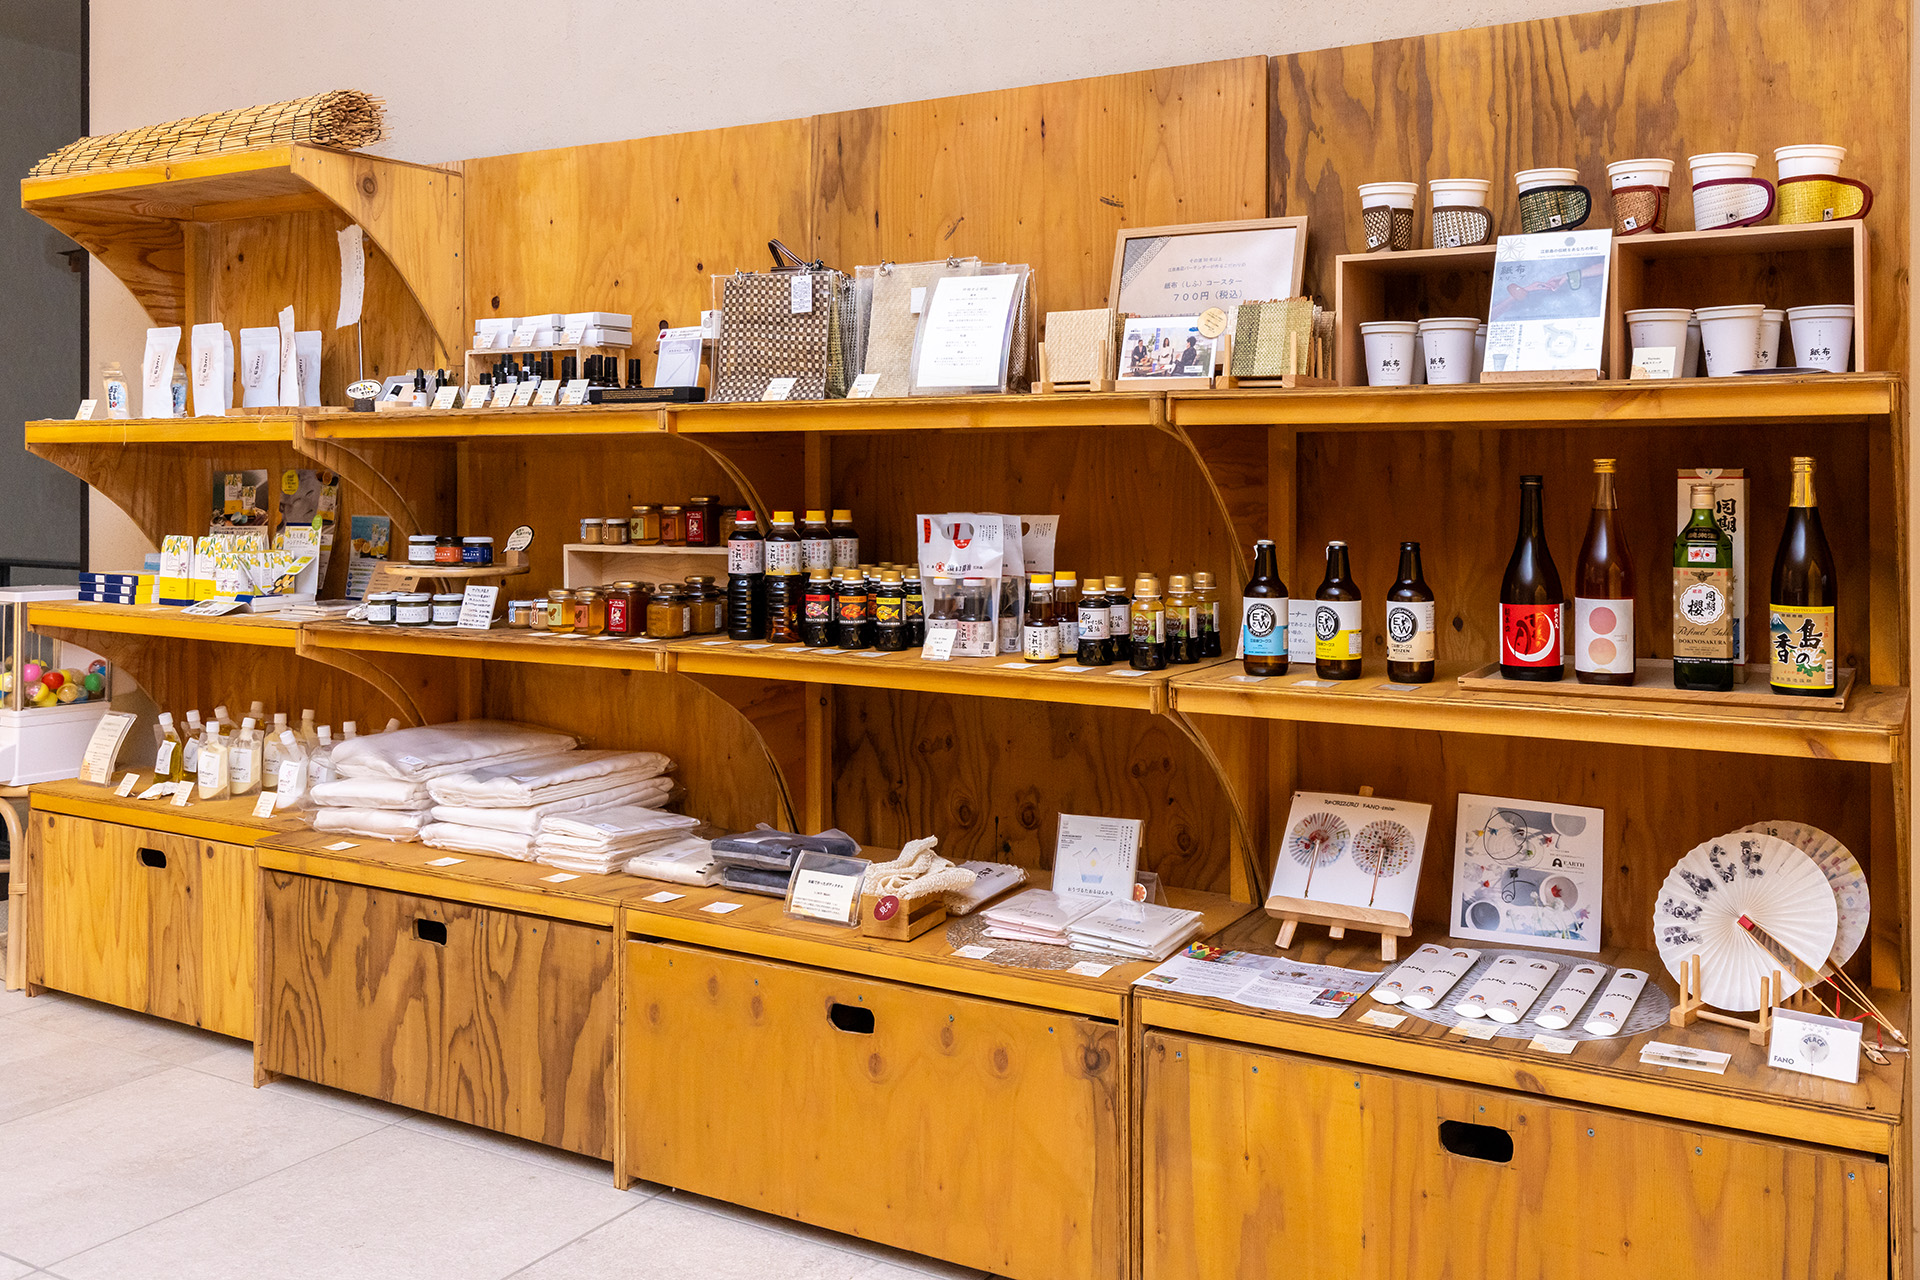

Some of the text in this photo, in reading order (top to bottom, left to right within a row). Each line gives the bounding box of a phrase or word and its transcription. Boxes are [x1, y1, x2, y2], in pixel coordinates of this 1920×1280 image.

[1500, 265, 1525, 275] 紙布
[1809, 347, 1831, 356] 紙布
[1773, 633, 1798, 664] 香
[880, 900, 893, 915] 見本
[1803, 1036, 1826, 1048] PEACE
[1773, 1055, 1795, 1065] FANO
